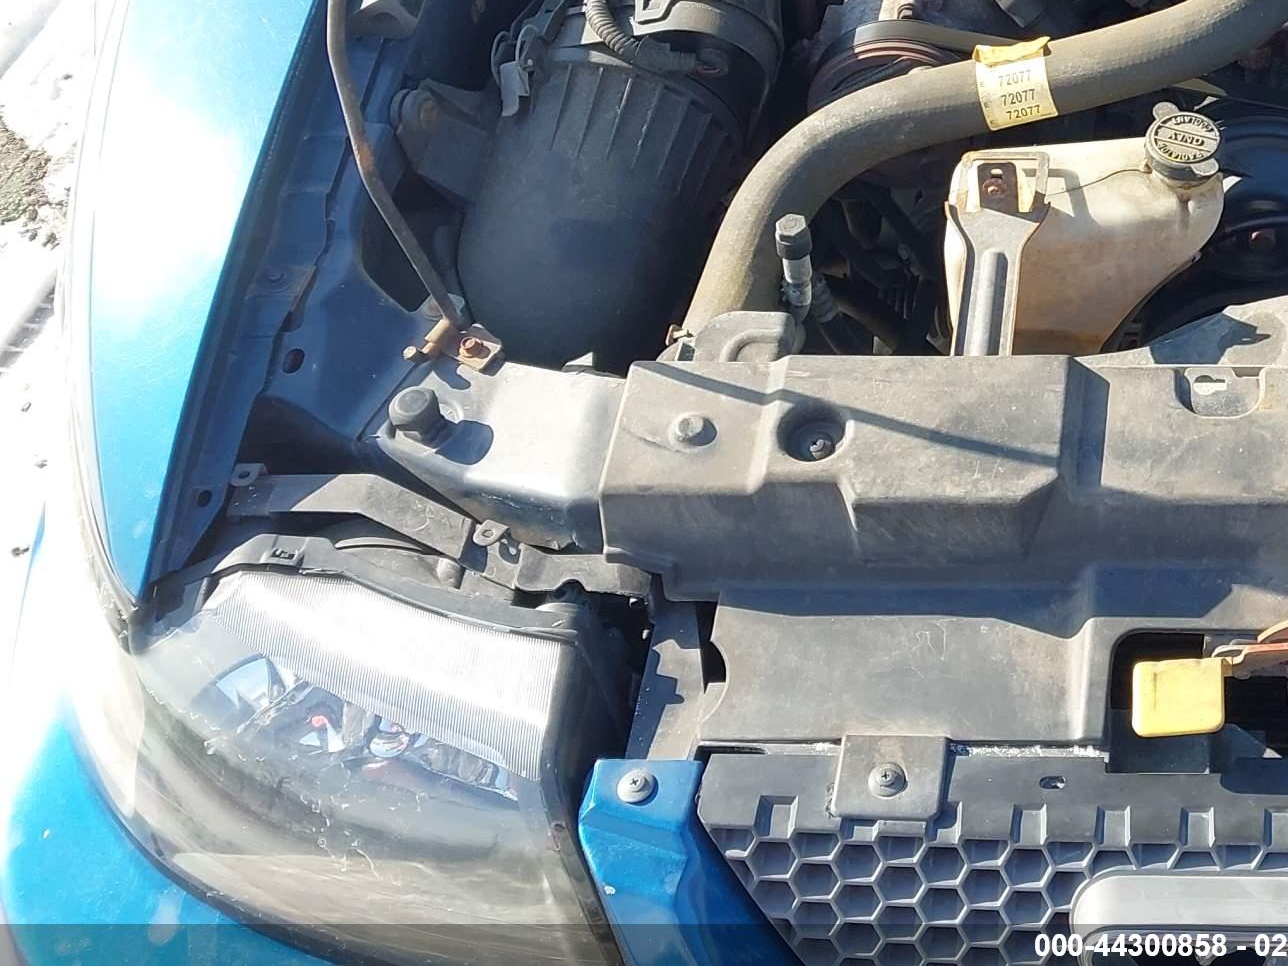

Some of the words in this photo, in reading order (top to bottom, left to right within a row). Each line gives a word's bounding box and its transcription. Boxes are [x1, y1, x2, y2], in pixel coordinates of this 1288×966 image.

[998, 69, 1032, 87] 72077
[1001, 88, 1036, 107] 72077
[1006, 104, 1041, 121] 72077
[1168, 132, 1206, 147] ONLY
